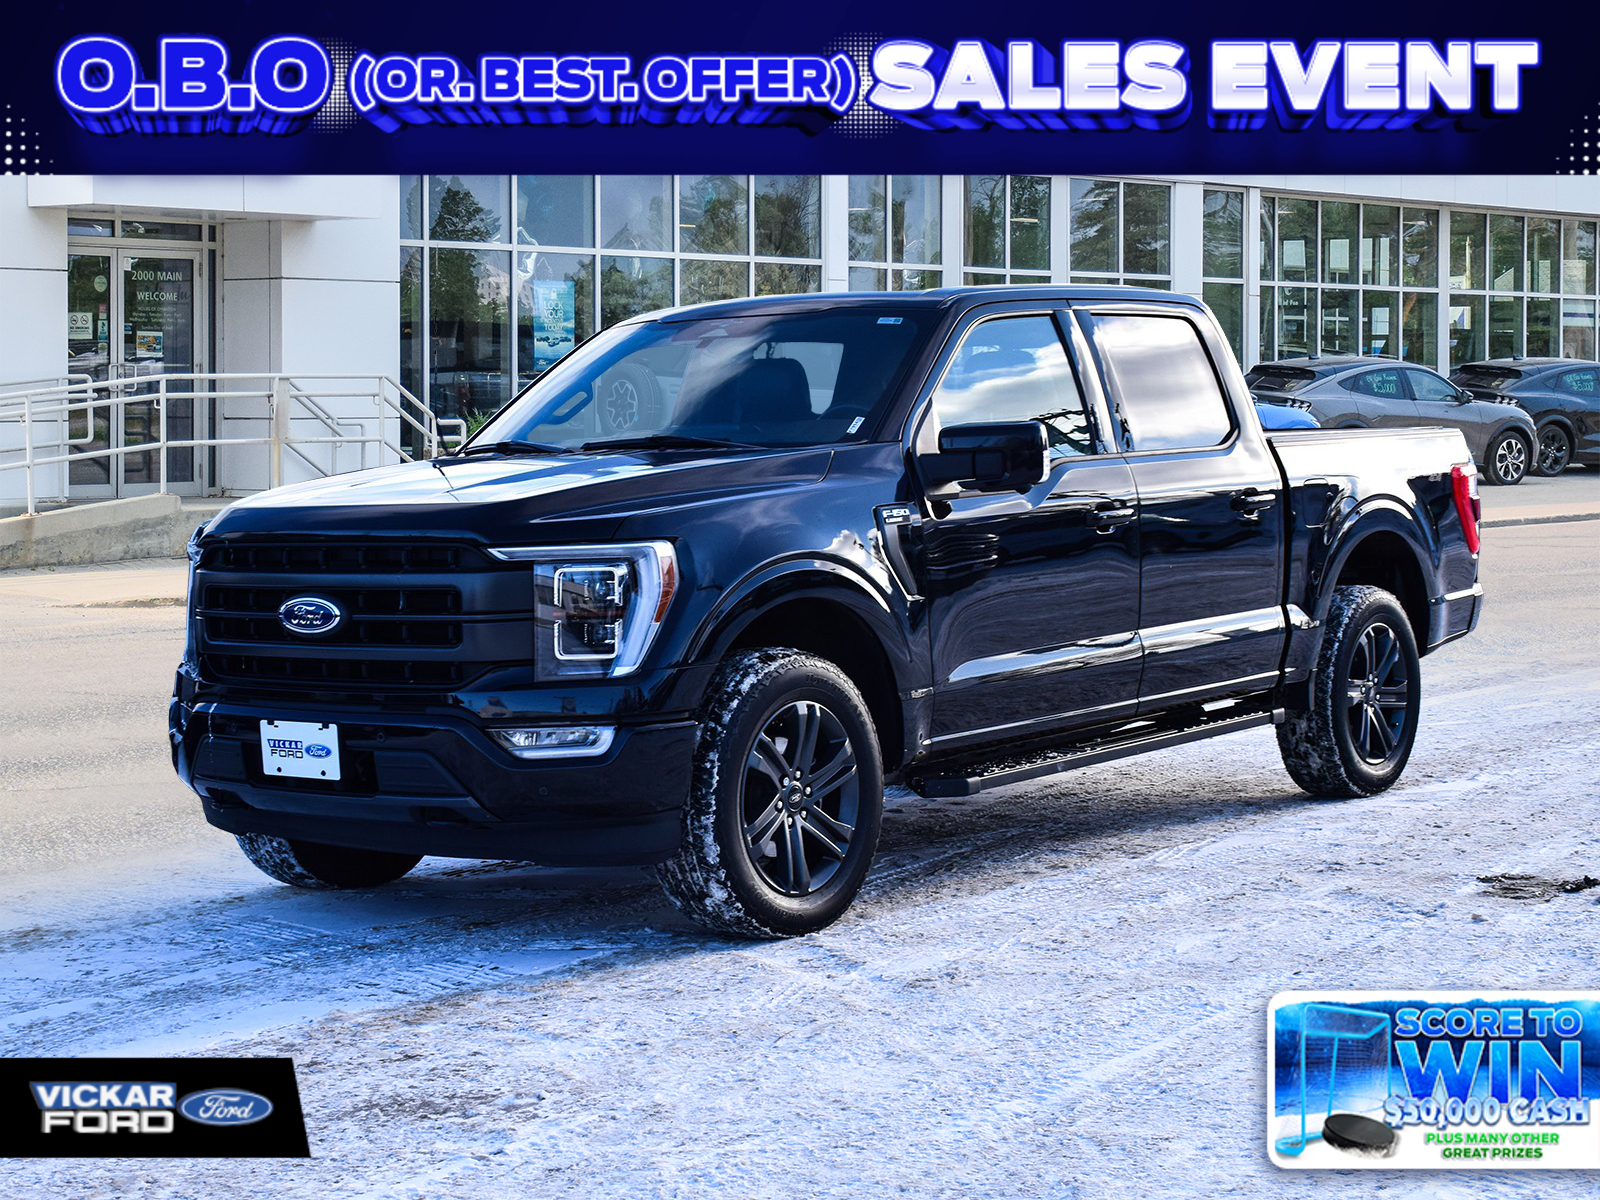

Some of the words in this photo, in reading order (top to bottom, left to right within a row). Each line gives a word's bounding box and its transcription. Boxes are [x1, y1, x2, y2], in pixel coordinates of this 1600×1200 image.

[131, 271, 154, 281] 2000
[157, 271, 183, 281] MAIN
[136, 291, 178, 301] WELCOME
[544, 309, 564, 318] YOUR
[883, 508, 910, 517] F-150
[291, 604, 324, 626] Ford
[269, 739, 303, 749] VICKAR
[271, 748, 304, 759] FORD
[309, 744, 327, 757] Ford
